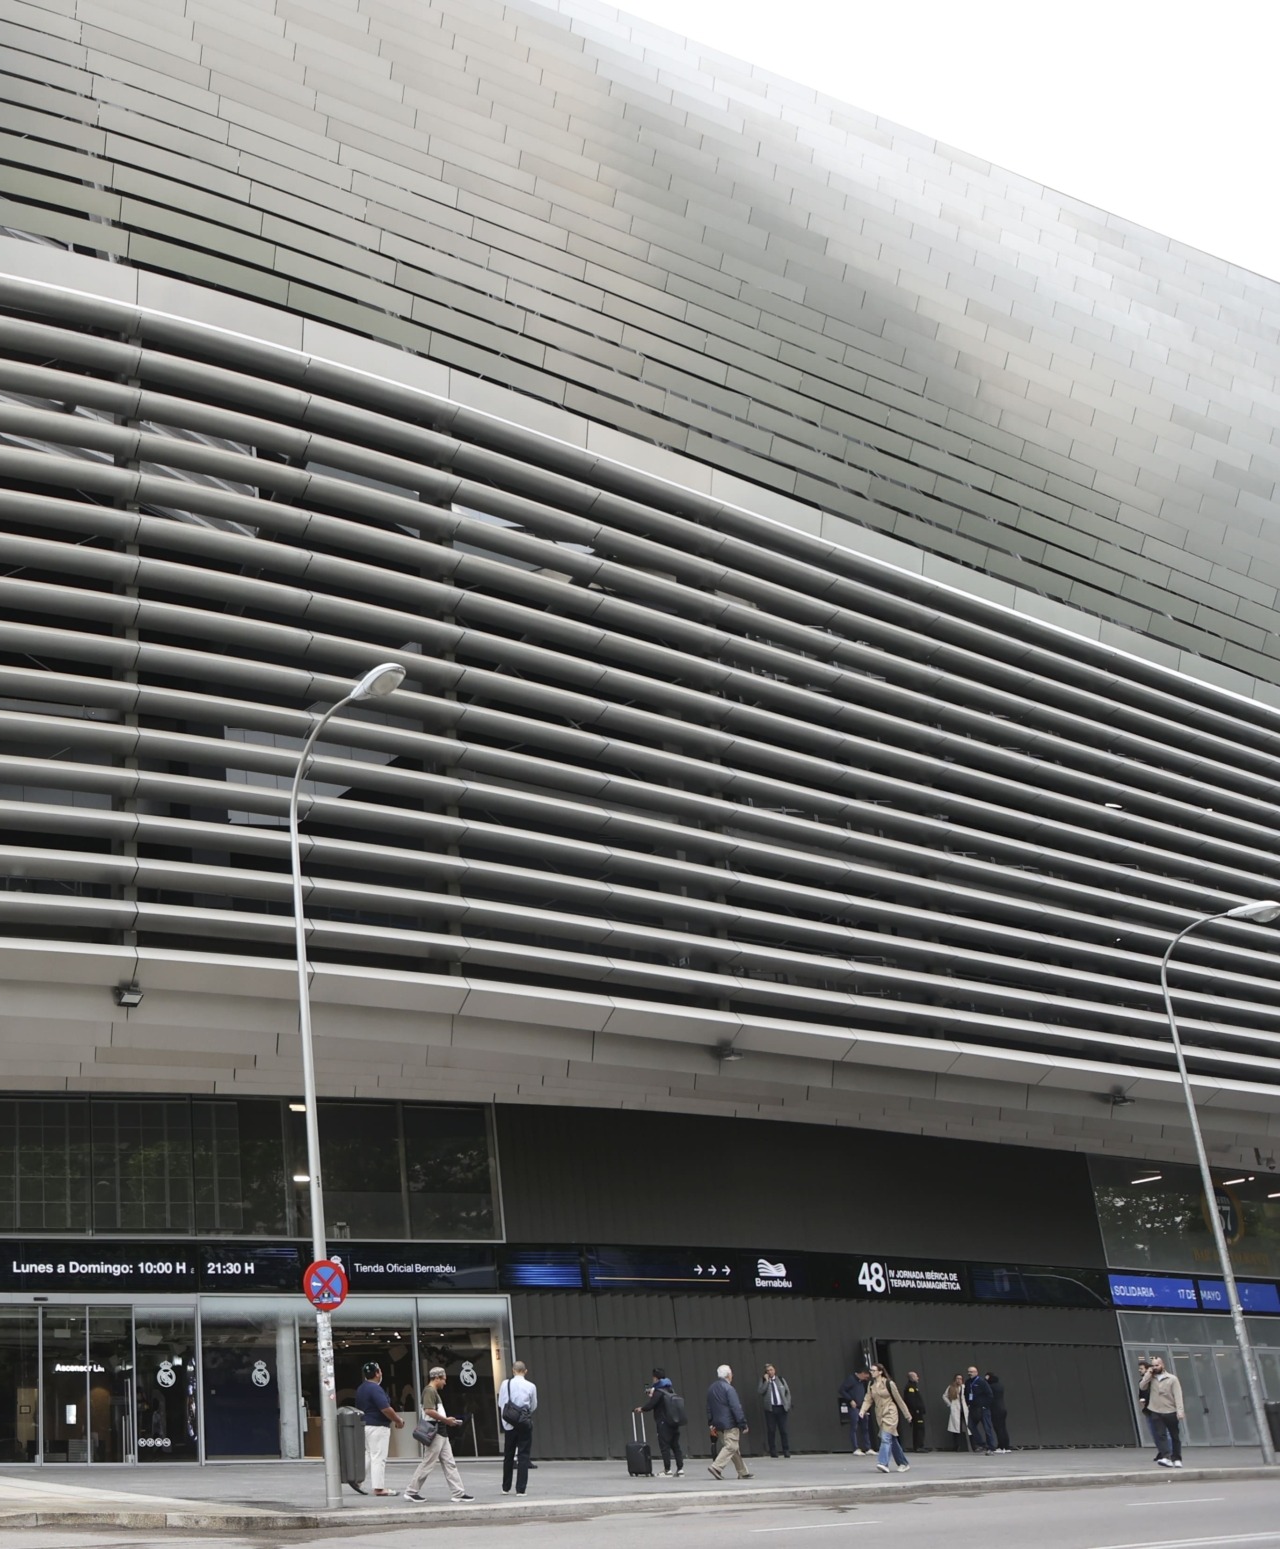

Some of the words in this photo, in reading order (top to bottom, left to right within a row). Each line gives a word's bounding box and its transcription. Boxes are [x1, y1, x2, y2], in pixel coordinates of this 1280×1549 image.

[12, 1260, 54, 1274] Lunes
[56, 1263, 65, 1274] a
[69, 1261, 134, 1277] Domingo:
[137, 1261, 173, 1274] 10:00
[175, 1261, 187, 1274] H
[207, 1262, 242, 1275] 21:30
[244, 1262, 255, 1275] H
[353, 1263, 385, 1273] Tienda
[385, 1263, 414, 1273] Oficial
[414, 1263, 457, 1274] Bernabéu
[857, 1261, 887, 1293] 48
[895, 1270, 925, 1280] JORNADA
[949, 1272, 959, 1282] DE
[754, 1277, 793, 1289] Bernabéu
[890, 1279, 916, 1289] TERAPIA
[1113, 1285, 1156, 1298] SOLIDARIA
[1200, 1290, 1222, 1301] MAYO
